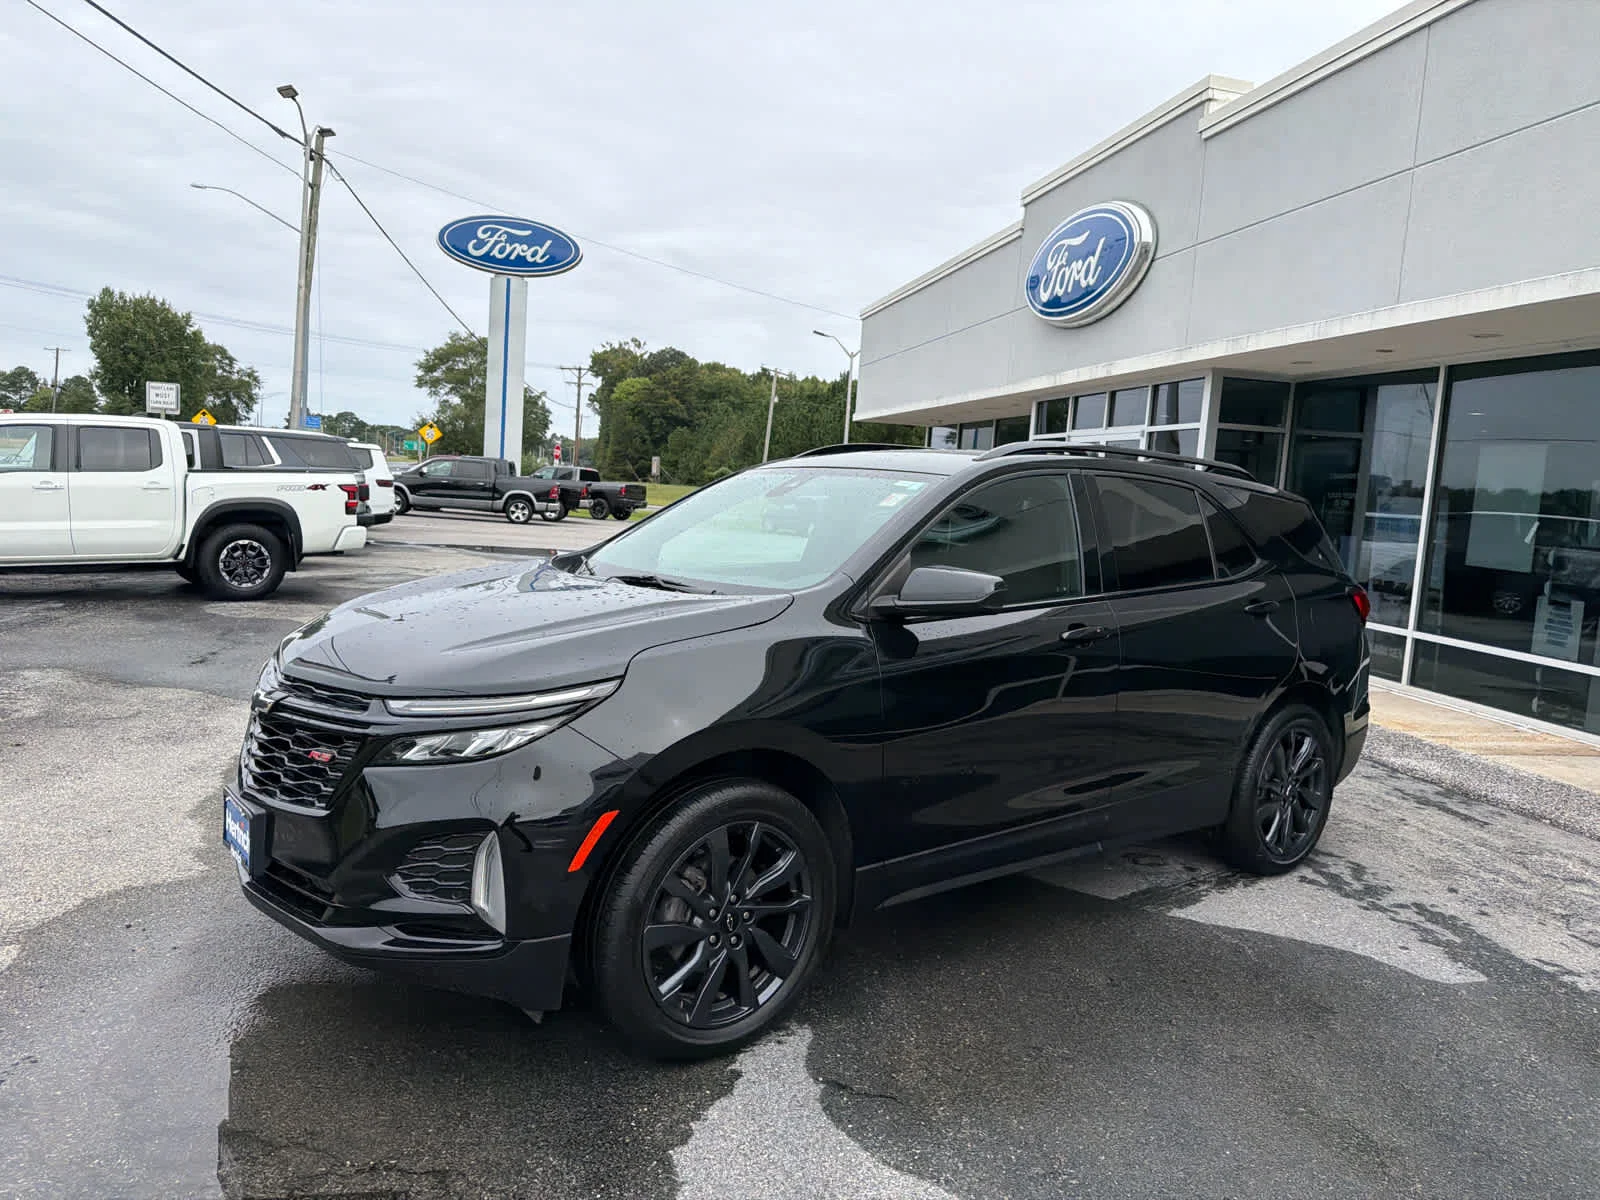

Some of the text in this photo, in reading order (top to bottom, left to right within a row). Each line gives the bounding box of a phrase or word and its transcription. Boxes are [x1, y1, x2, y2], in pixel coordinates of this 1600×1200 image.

[467, 224, 553, 264] Ford
[1040, 230, 1106, 303] Ford
[308, 750, 331, 762] RS
